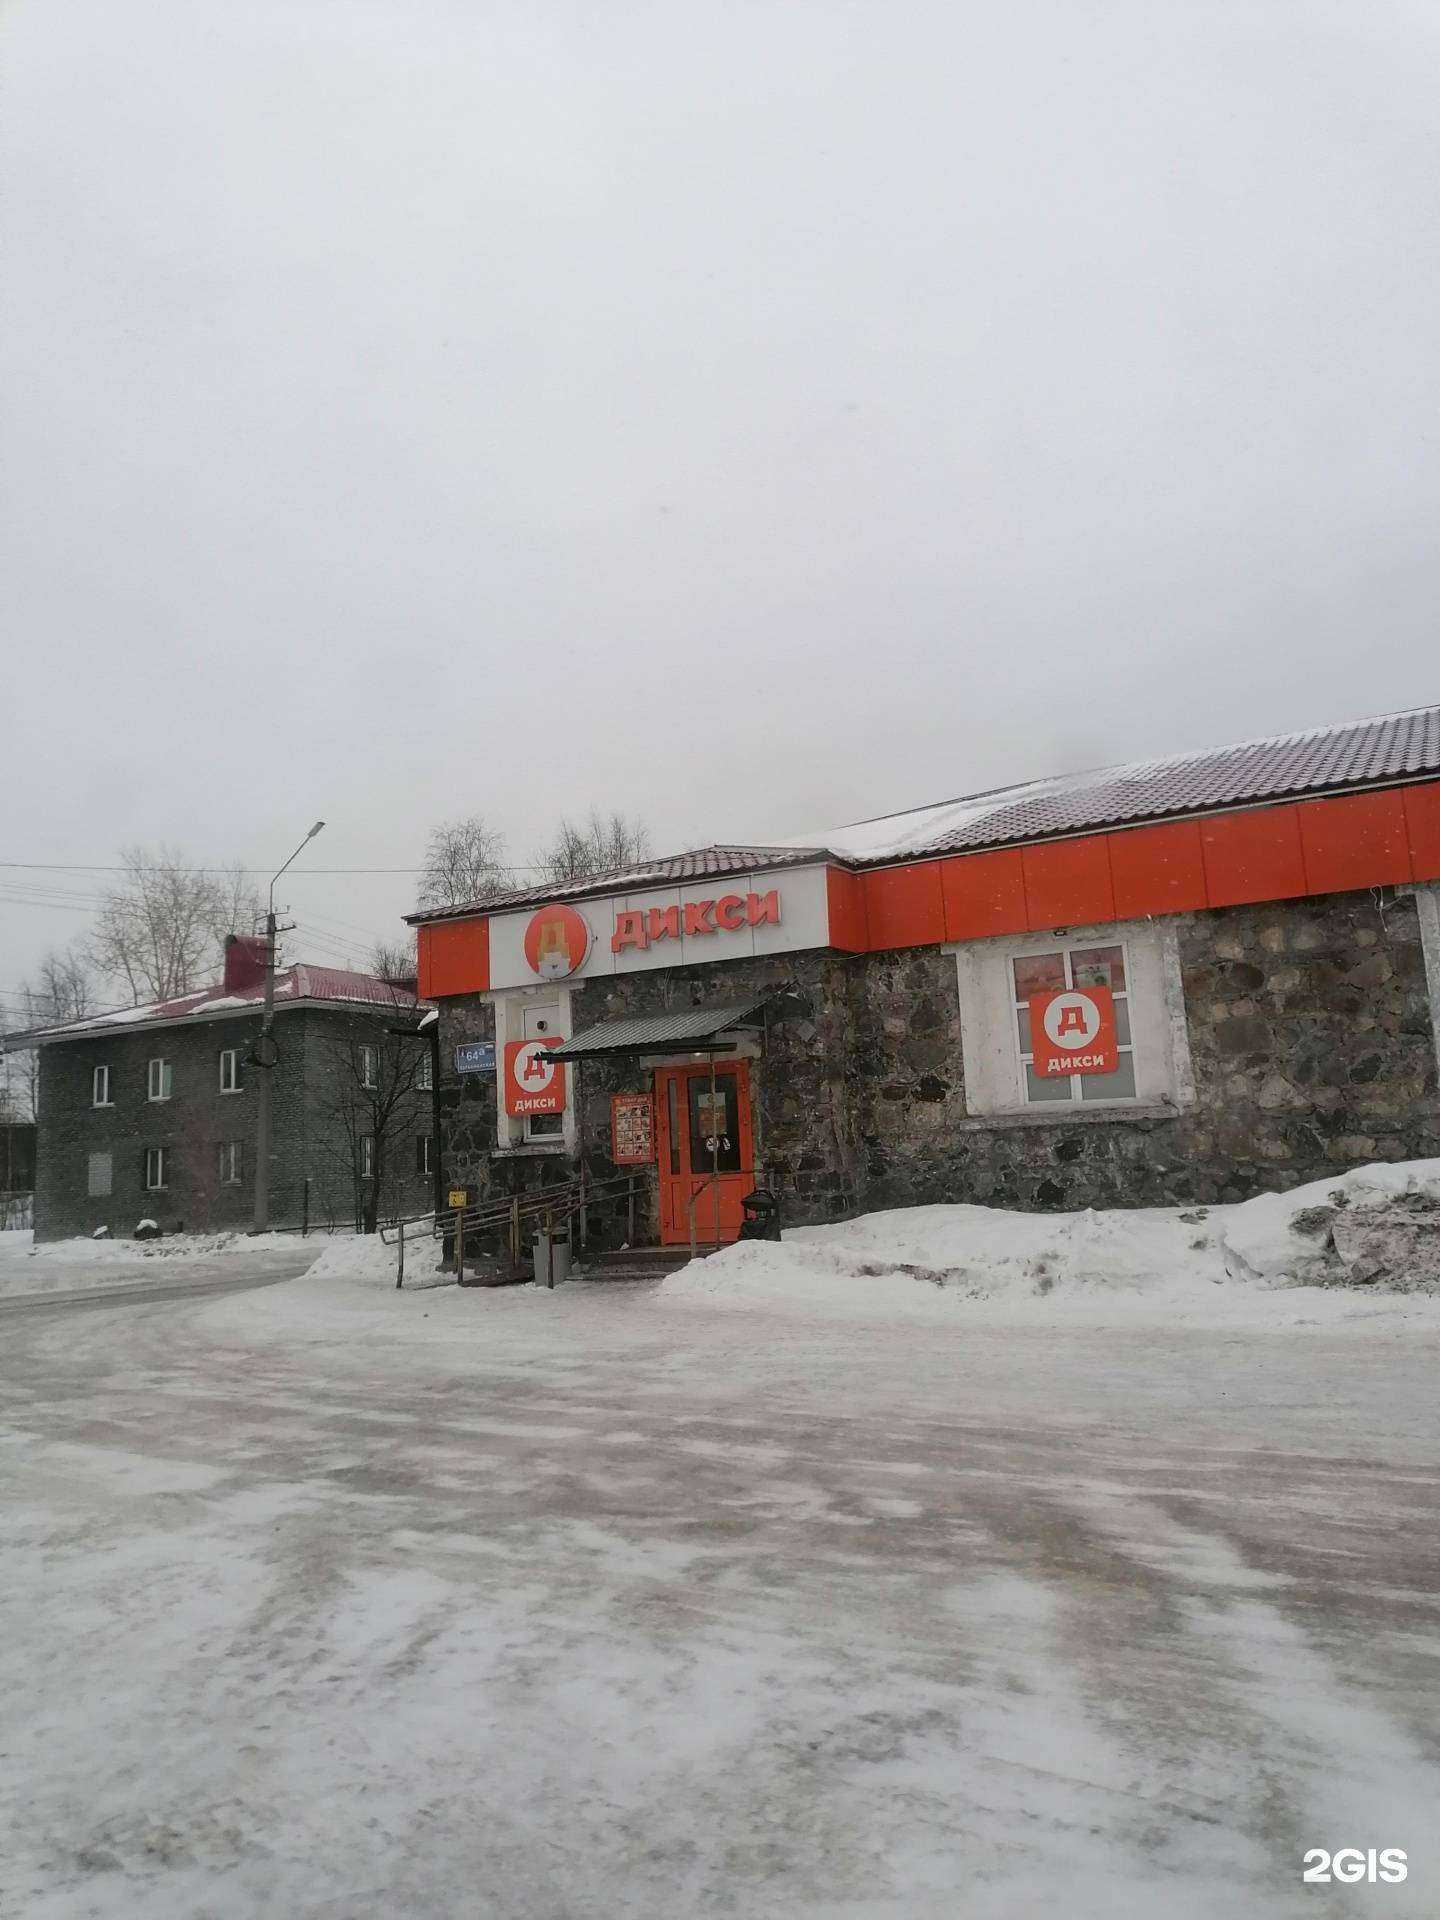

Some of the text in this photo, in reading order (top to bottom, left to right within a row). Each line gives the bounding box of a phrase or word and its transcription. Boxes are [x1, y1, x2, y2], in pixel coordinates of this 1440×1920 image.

[611, 890, 779, 954] ДИКСИ
[537, 920, 570, 962] Д
[1057, 1006, 1088, 1036] Д
[523, 1055, 546, 1081] Д
[1047, 1054, 1105, 1071] ДИКСИ
[514, 1097, 556, 1112] ДИКСИ
